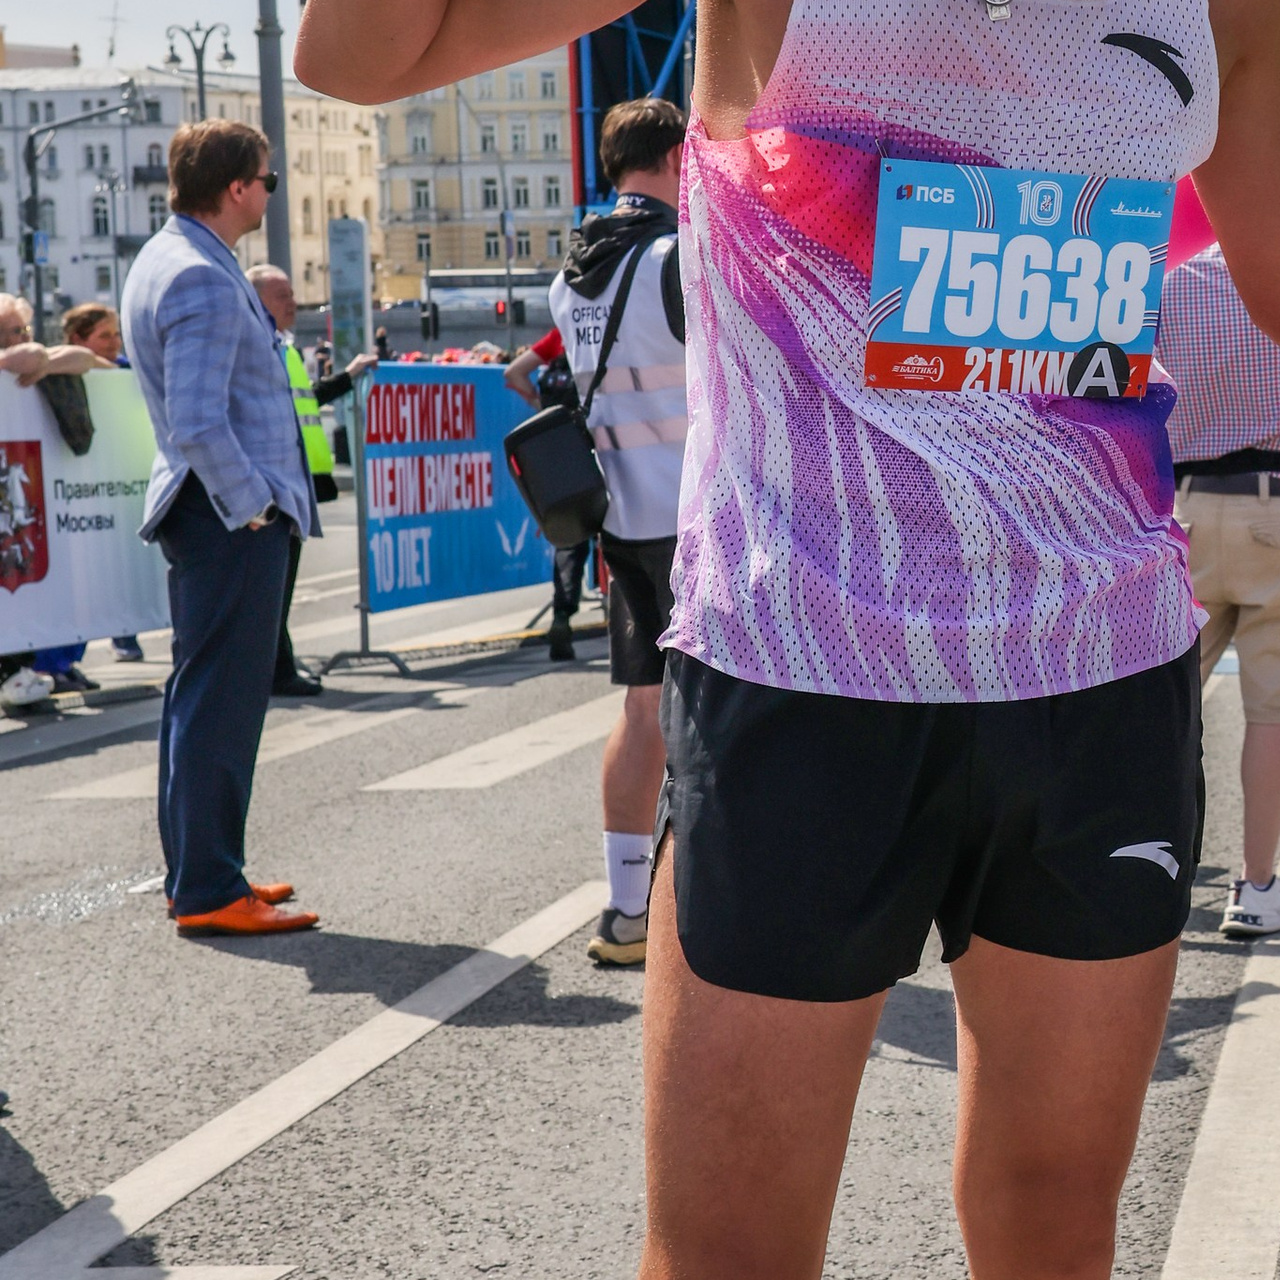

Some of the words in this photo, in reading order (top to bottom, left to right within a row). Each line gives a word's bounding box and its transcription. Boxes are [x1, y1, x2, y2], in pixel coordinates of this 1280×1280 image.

[917, 185, 955, 204] ПСБ
[1017, 180, 1063, 227] 10
[899, 226, 1152, 345] 75638
[900, 366, 938, 375] БАЛТИКА
[366, 384, 476, 444] ДОСТИГАЕМ
[366, 455, 420, 526] ЦЕЛИ
[424, 452, 493, 514] ВМЕСТЕ
[56, 514, 115, 532] Москвы
[370, 531, 395, 594] 10
[398, 526, 431, 589] ЛЕТ
